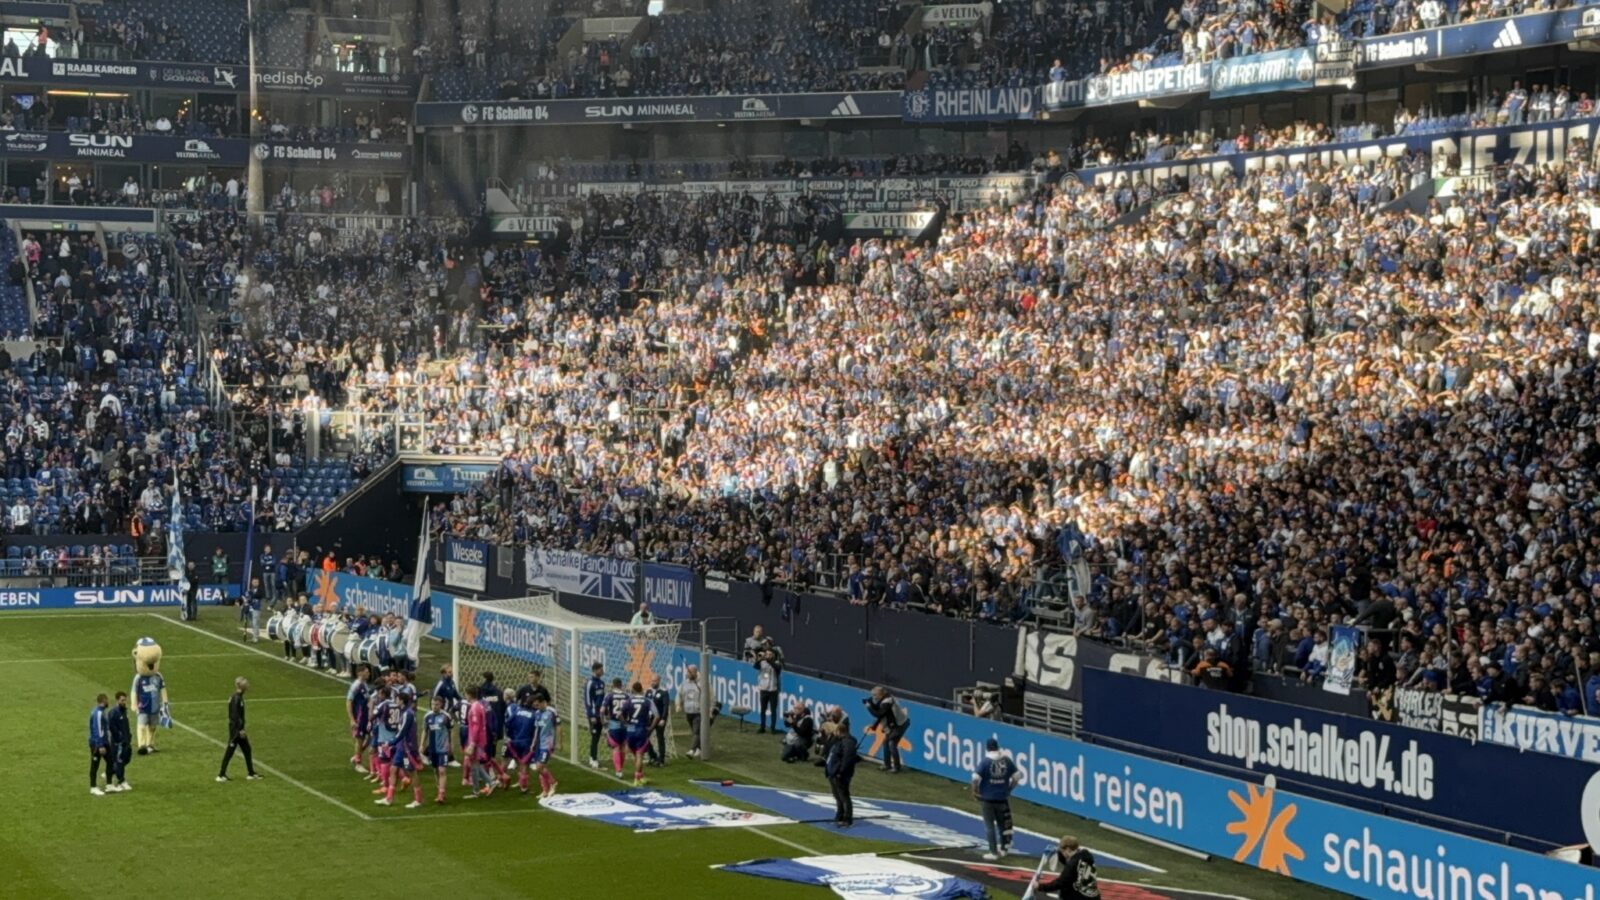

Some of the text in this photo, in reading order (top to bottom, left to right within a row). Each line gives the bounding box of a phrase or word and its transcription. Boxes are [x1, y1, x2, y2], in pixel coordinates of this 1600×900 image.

[941, 7, 980, 19] VELTIN
[67, 63, 93, 73] RAAB
[94, 64, 137, 75] KARCHER
[935, 87, 1032, 115] RHEINLAND
[482, 105, 549, 121] FC Schalke 04
[585, 104, 695, 118] SUN MINIMEAL
[69, 134, 133, 148] SUN
[77, 147, 125, 158] MINIMEAL
[273, 146, 336, 160] FC Schalke 04
[872, 214, 925, 228] VELTINS
[581, 554, 618, 576] FanClub
[621, 560, 636, 578] UK
[74, 590, 143, 605] SUN
[645, 577, 678, 606] PLAUEN
[345, 583, 409, 619] schauinsland
[484, 614, 554, 657] schauinslan
[633, 704, 641, 719] 7
[1207, 703, 1435, 801] shop.schalke04.de
[1092, 764, 1184, 830] reisen
